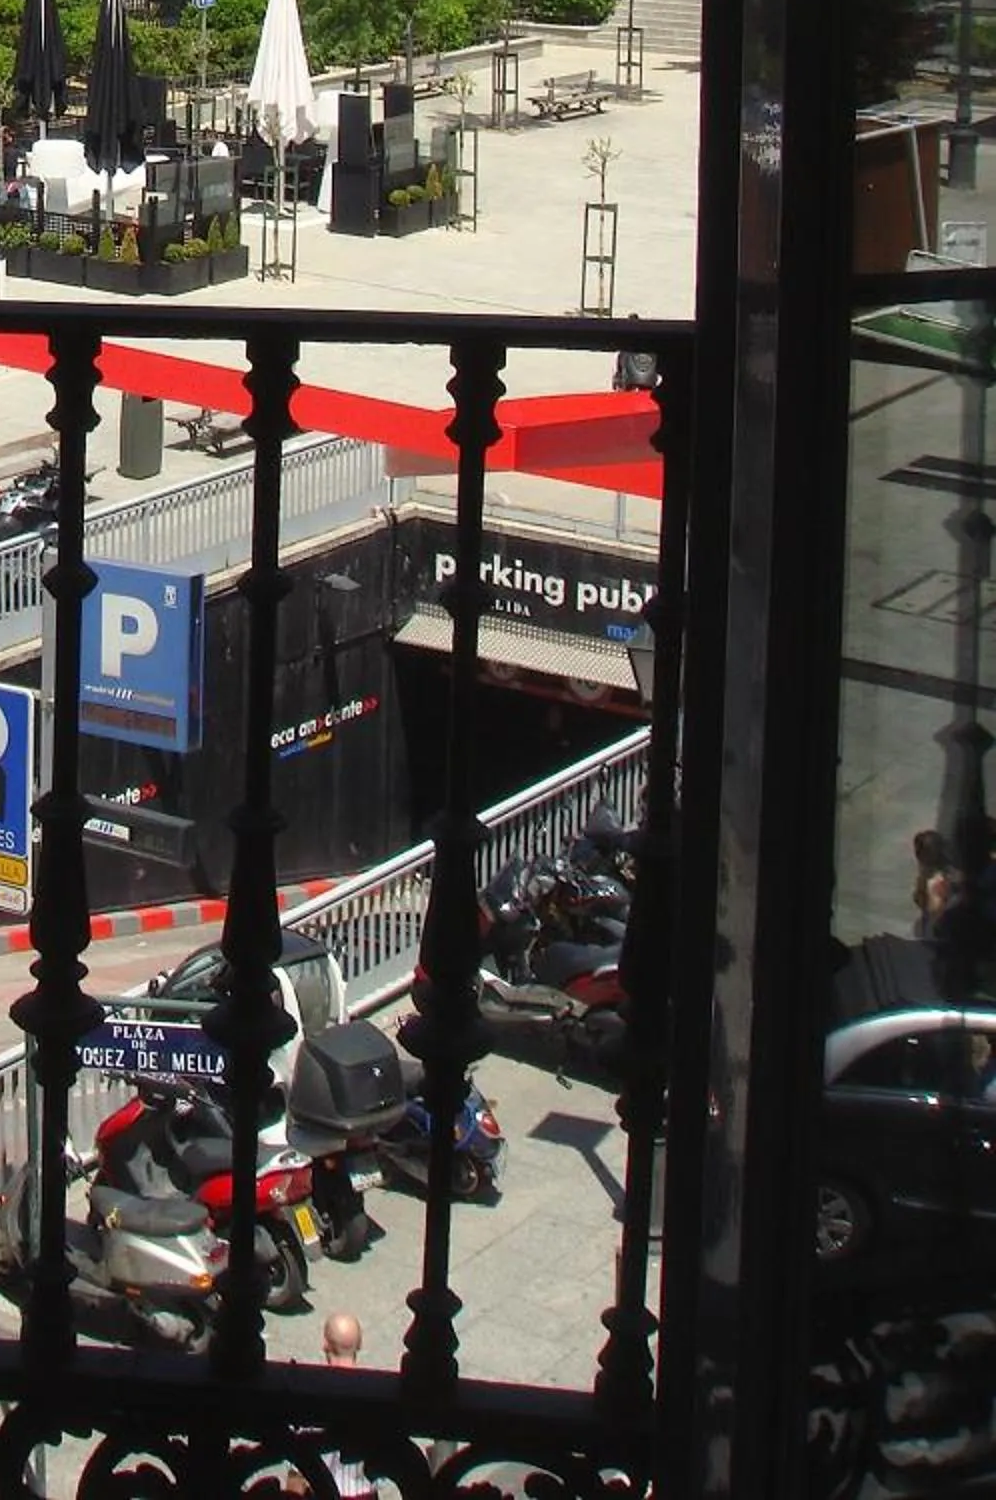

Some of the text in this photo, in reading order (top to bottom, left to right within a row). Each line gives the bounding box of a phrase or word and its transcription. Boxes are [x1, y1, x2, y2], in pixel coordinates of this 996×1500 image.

[435, 553, 659, 613] prking publ
[490, 599, 531, 617] LIDA
[101, 592, 159, 678] P
[112, 1025, 165, 1041] PLAZA
[131, 1039, 148, 1050] DE
[75, 1045, 225, 1075] QUEZ DE MELLA
